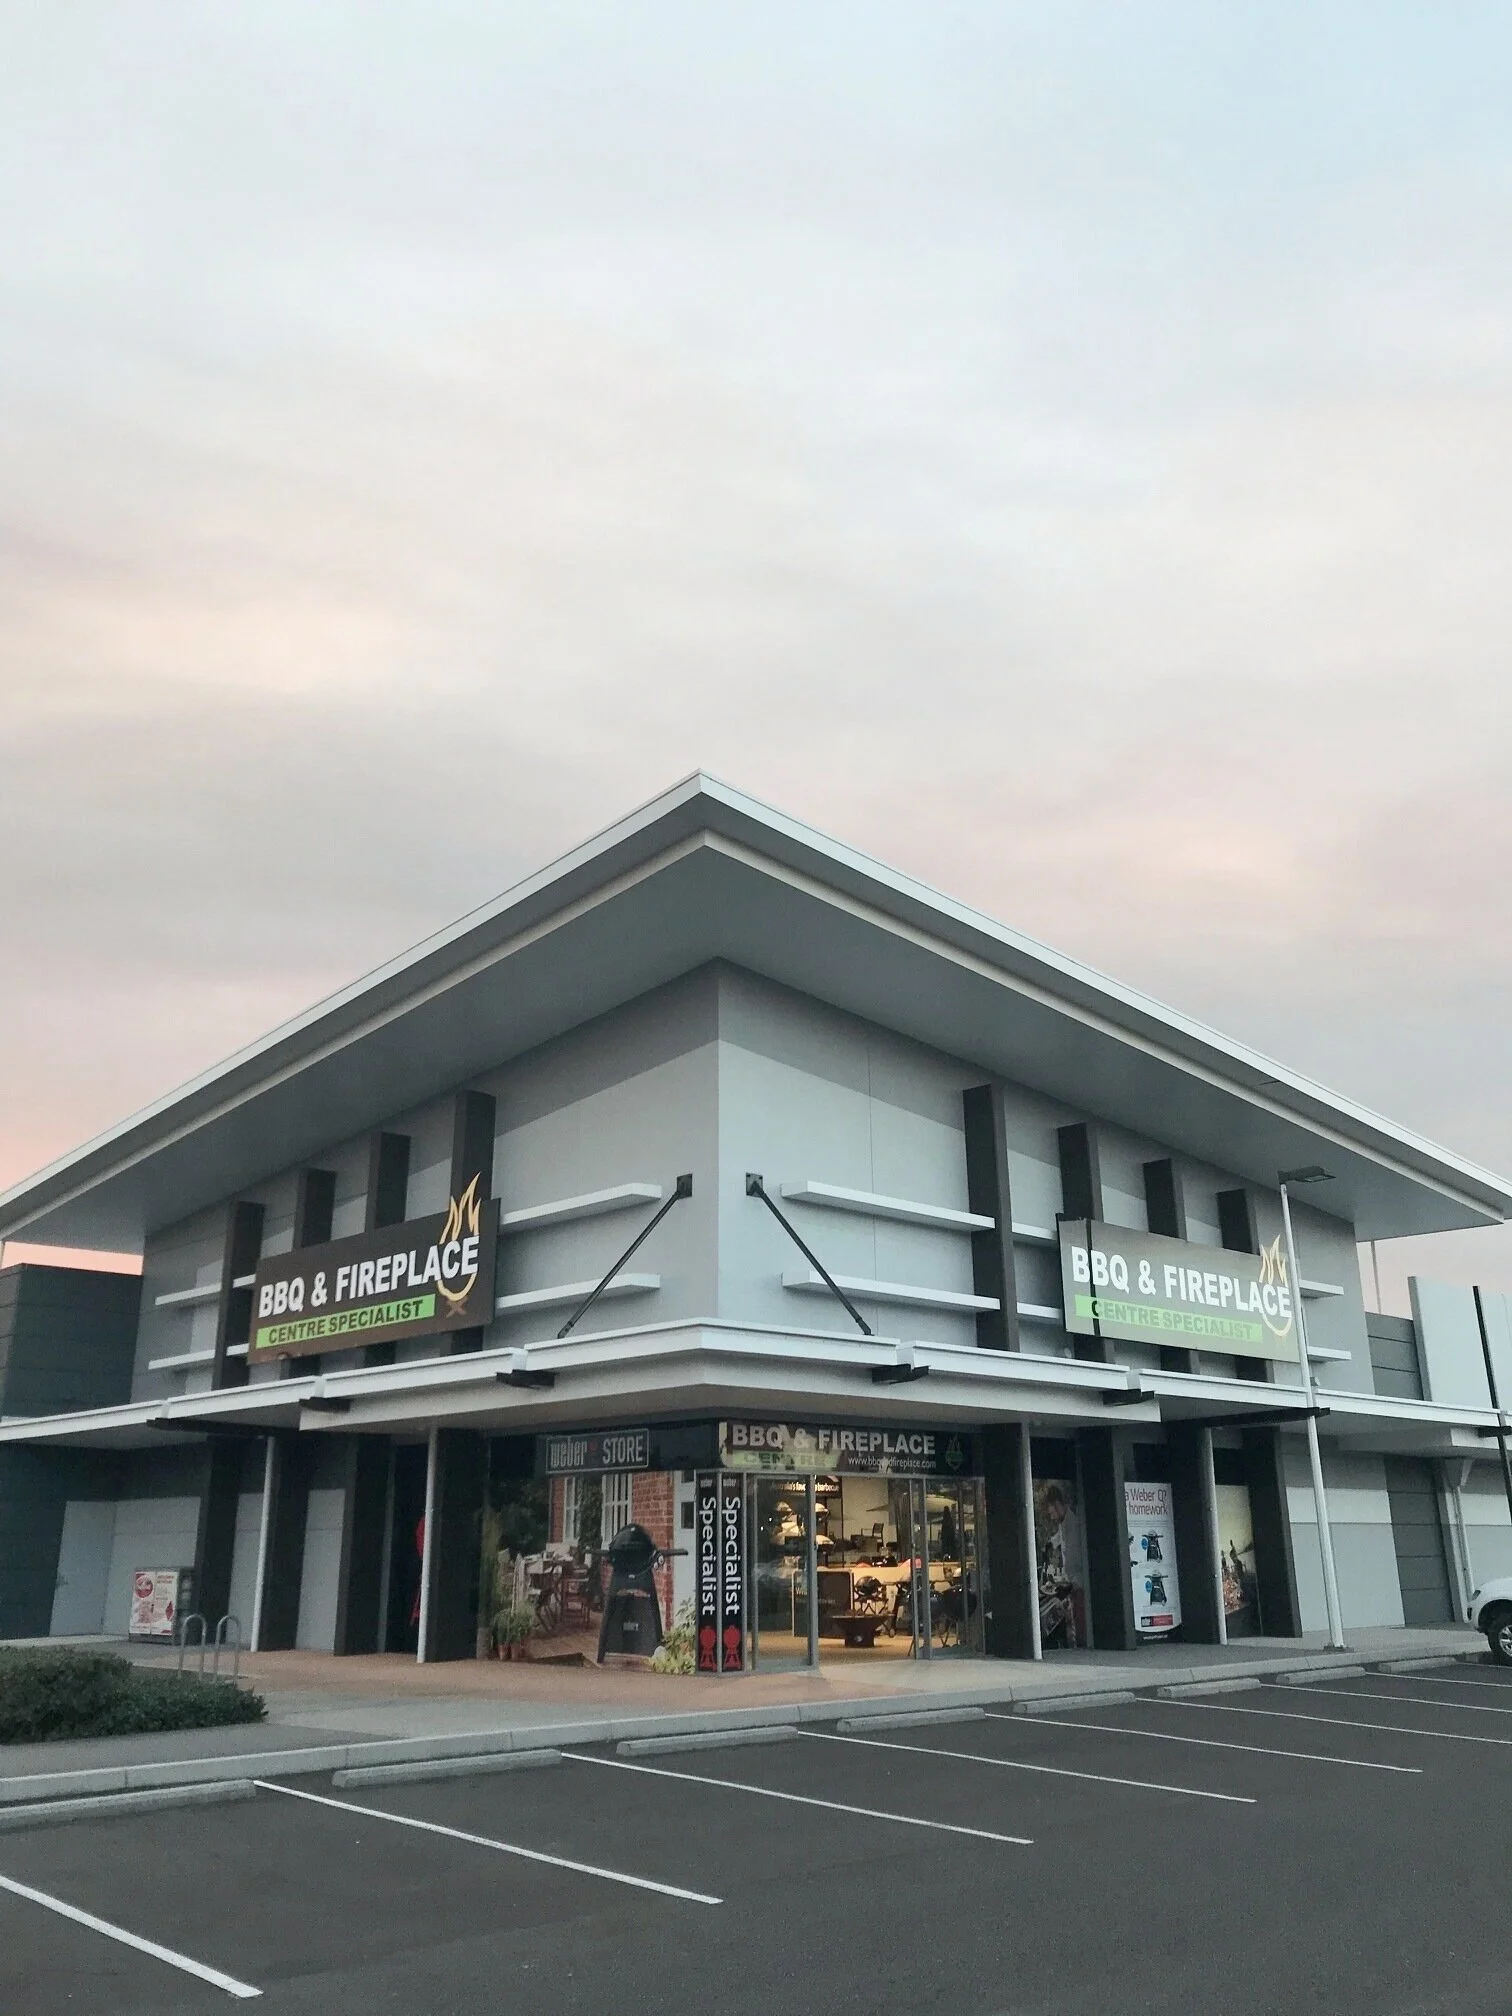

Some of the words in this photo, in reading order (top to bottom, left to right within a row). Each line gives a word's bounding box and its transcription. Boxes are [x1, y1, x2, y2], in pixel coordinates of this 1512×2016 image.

[258, 1276, 305, 1318] BBQ
[310, 1271, 327, 1307] &
[335, 1235, 480, 1303] FIREPLACE
[1071, 1246, 1130, 1294] BBQ
[1138, 1259, 1156, 1296] &
[1163, 1264, 1293, 1318] FIREPLACE
[268, 1319, 325, 1344] CENTRE
[328, 1300, 423, 1332] SPECIALIST
[1091, 1300, 1160, 1323] CENTRE
[1162, 1311, 1253, 1340] SPECIALIST
[550, 1436, 588, 1467] weber
[602, 1435, 643, 1464] STORE
[732, 1424, 783, 1449] BBQ
[793, 1427, 811, 1449] &
[818, 1429, 936, 1455] FIREPLACE
[1128, 1501, 1168, 1516] homework
[1130, 1488, 1155, 1501] Weber
[700, 1496, 717, 1616] Specialist
[721, 1496, 741, 1616] Specialist
